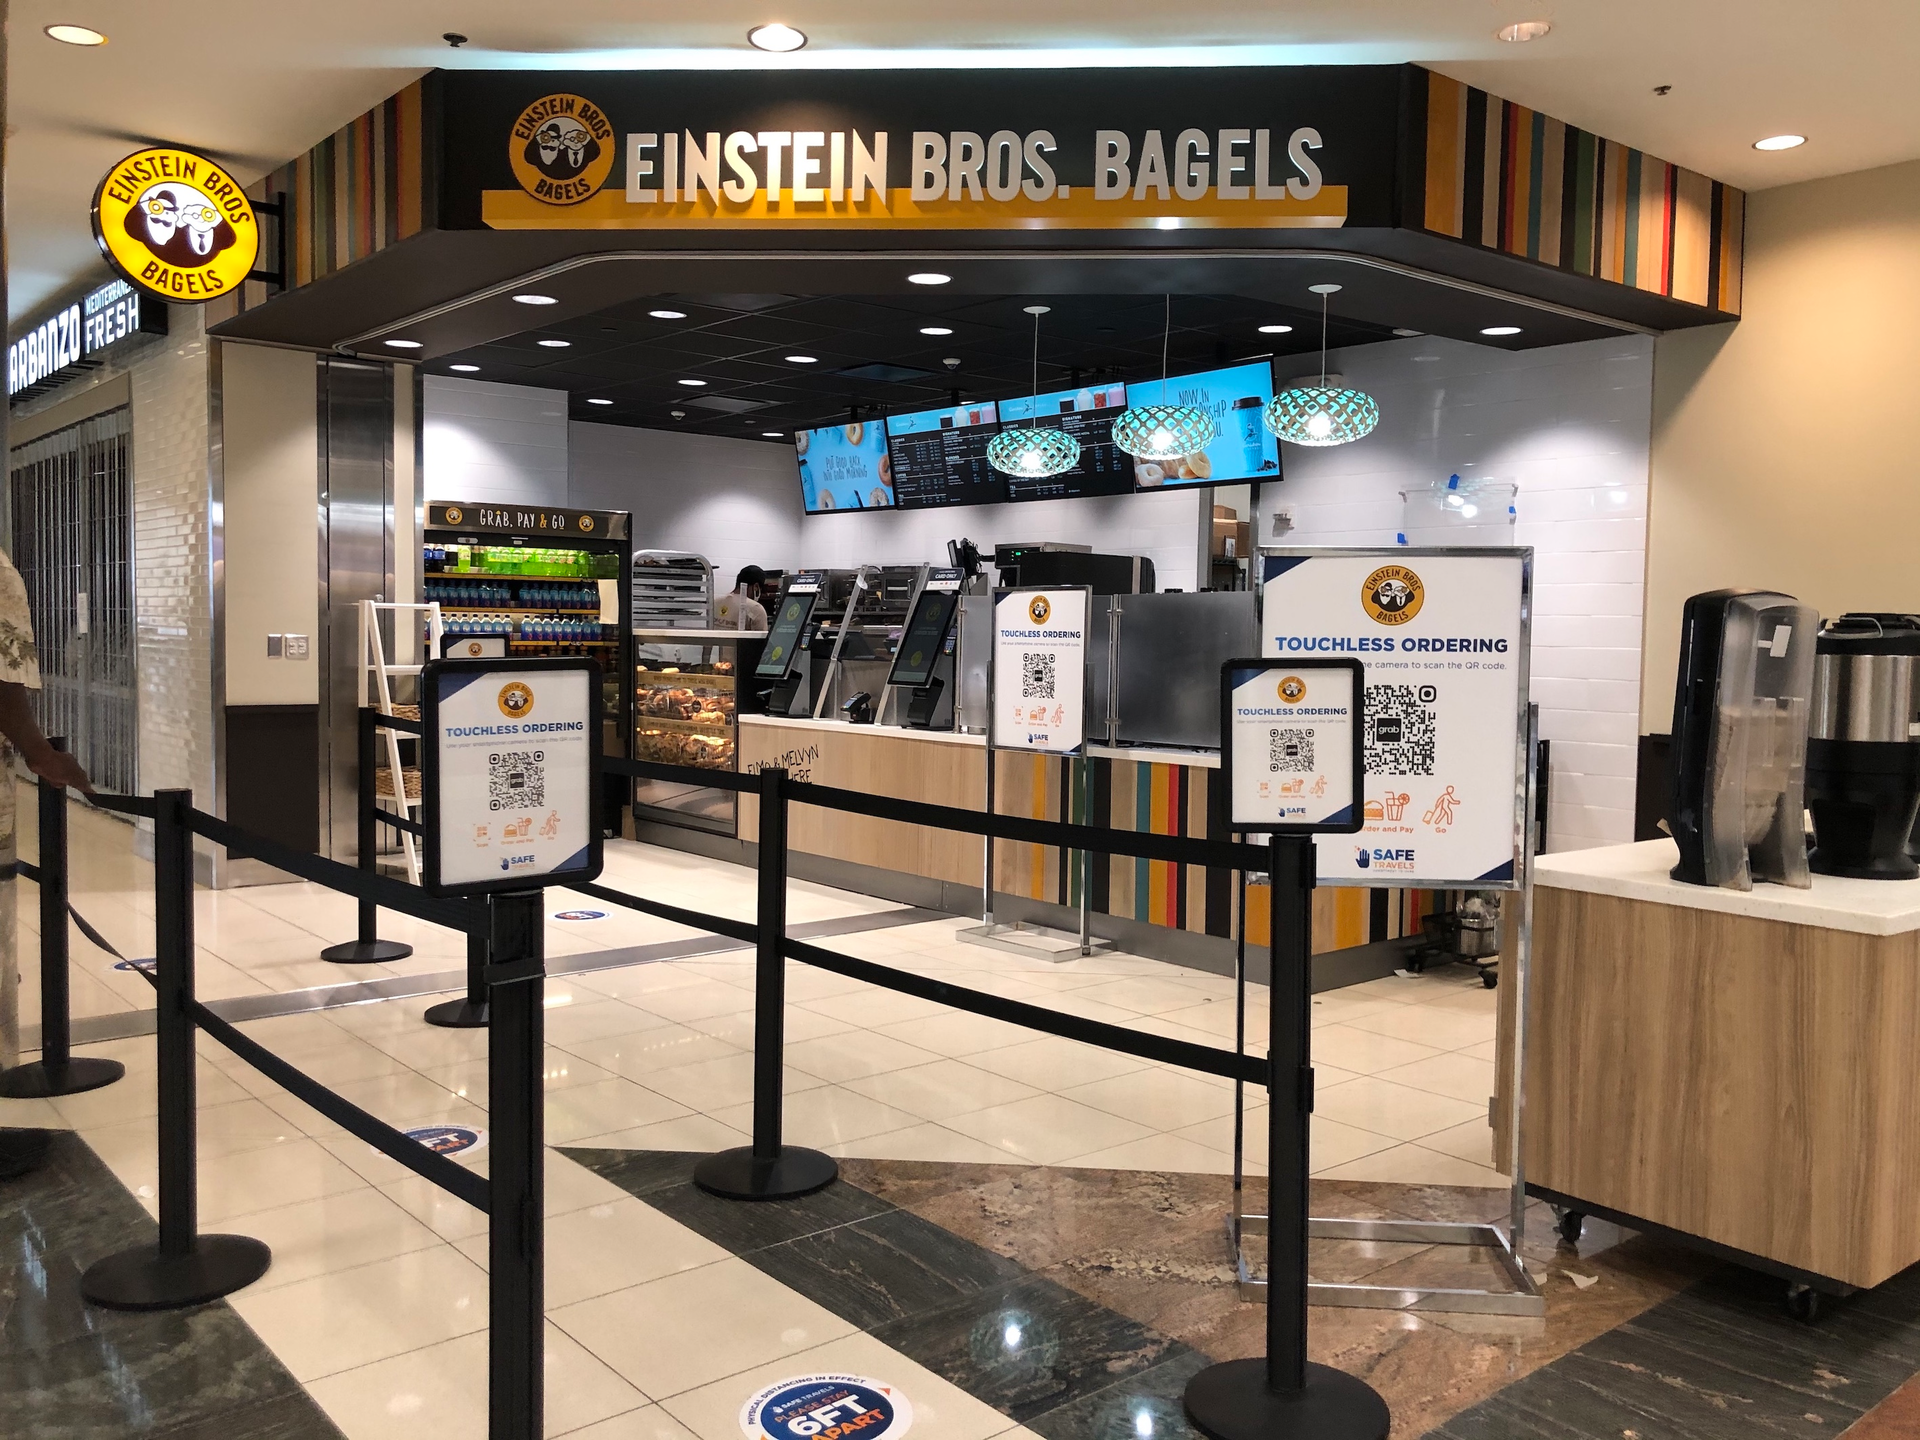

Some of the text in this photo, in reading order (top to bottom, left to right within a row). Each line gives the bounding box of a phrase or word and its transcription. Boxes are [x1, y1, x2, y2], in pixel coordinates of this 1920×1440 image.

[515, 97, 610, 140] EINSTEIN BROS
[625, 127, 1324, 213] EINSTEIN BROS. BAGELS
[108, 155, 250, 224] EINSTEIN BROS
[534, 178, 591, 200] BAGELS
[141, 260, 223, 294] BAGELS
[86, 278, 134, 316] MEDITERRAN
[86, 293, 139, 354] FRESH
[9, 303, 81, 395] ARBANZO
[1178, 387, 1210, 406] NOW IN
[517, 512, 535, 528] PAY
[540, 513, 547, 529] &
[551, 514, 565, 529] GO
[1365, 568, 1421, 592] EINSTEIN BROS
[1376, 610, 1409, 623] BAGELS
[1001, 630, 1081, 639] TOUCHLESS ORDERING
[1275, 636, 1508, 653] TOUCHLESS ORDERING
[1374, 661, 1409, 669] camera
[1411, 660, 1421, 669] to
[1423, 662, 1445, 670] scan
[1447, 660, 1462, 670] the
[1465, 661, 1480, 670] QR
[1482, 661, 1507, 670] code.
[1237, 707, 1347, 716] TOUCHLESS ORDERING
[446, 721, 584, 738] TOUCHLESS ORDERING
[1033, 733, 1049, 741] SAFE
[1378, 725, 1400, 735] grab
[781, 744, 819, 769] MELVYN
[1361, 825, 1414, 834] rder and Pay
[510, 854, 535, 864] SAFE
[1373, 848, 1415, 861] SAFE
[1373, 861, 1415, 870] TRAVELS
[419, 1132, 460, 1148] FT
[748, 1397, 763, 1426] PHYSICAL
[761, 1377, 813, 1399] DISTANCING
[828, 1376, 867, 1384] EFFECT
[801, 1385, 835, 1401] TRAVELS
[774, 1389, 849, 1423] PLEASE STAY
[787, 1394, 869, 1436] 6FT
